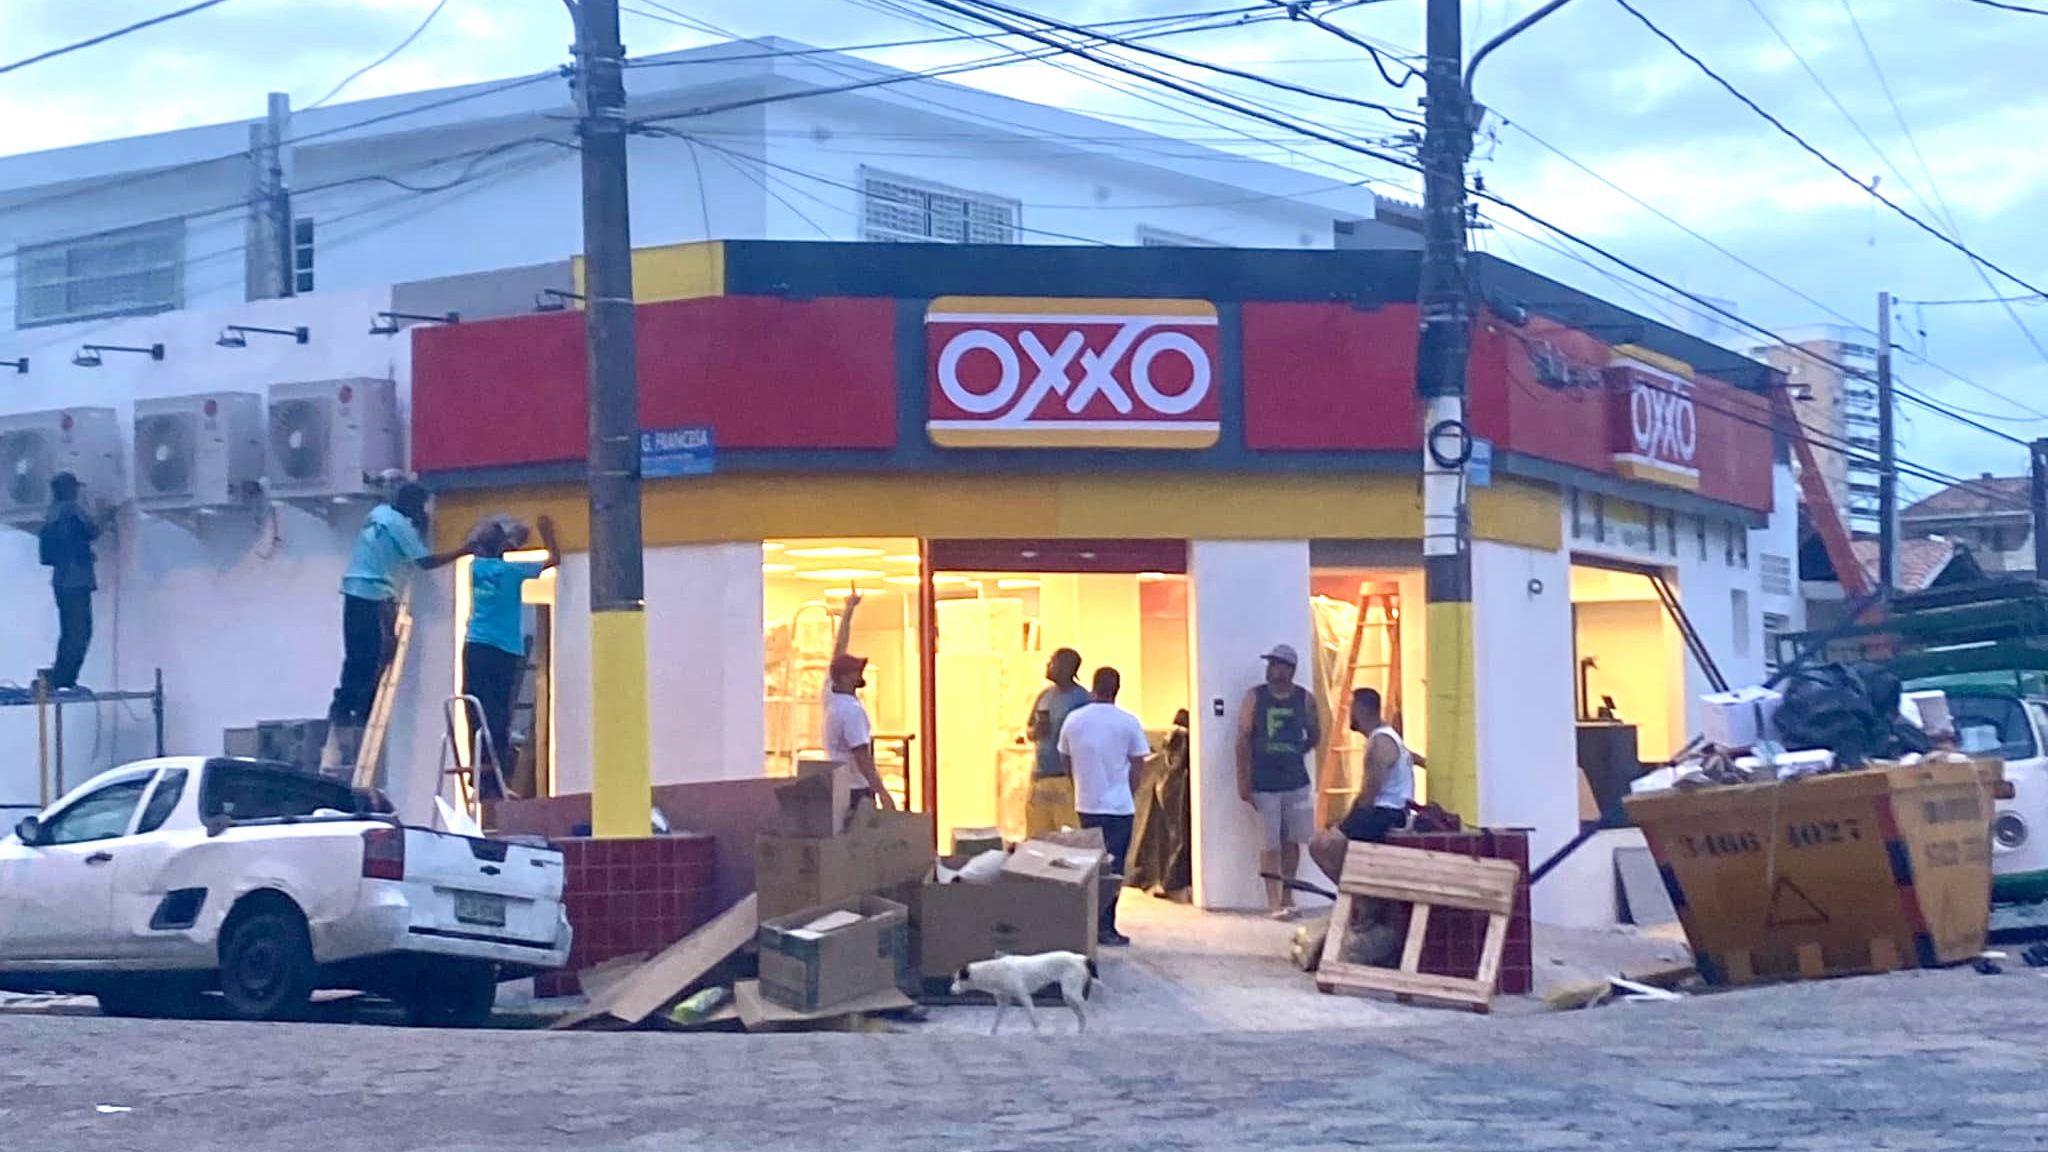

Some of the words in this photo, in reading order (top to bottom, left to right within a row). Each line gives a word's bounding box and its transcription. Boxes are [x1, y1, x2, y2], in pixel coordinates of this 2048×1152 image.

[936, 326, 1212, 421] OXXO
[1631, 382, 1697, 461] OXXO
[1266, 707, 1294, 738] F
